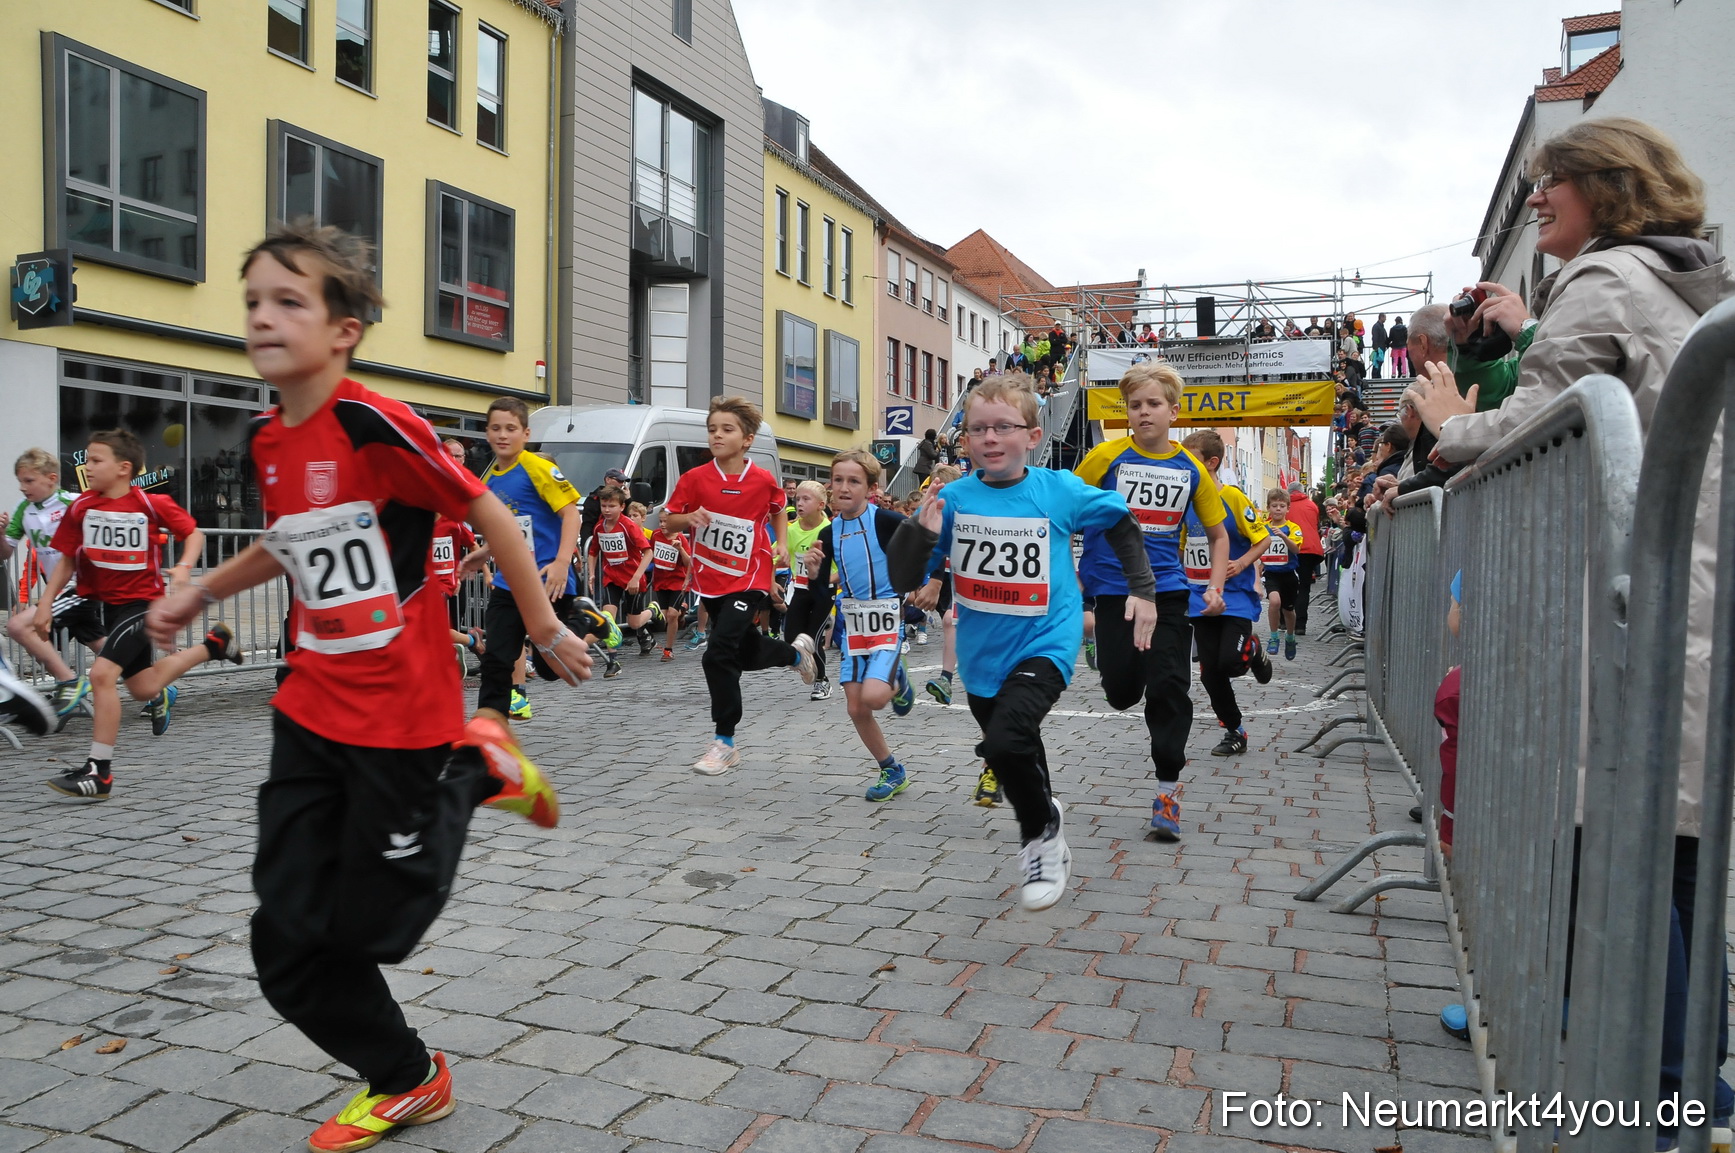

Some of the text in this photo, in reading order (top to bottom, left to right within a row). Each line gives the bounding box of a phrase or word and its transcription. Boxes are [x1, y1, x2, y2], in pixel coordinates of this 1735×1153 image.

[1160, 350, 1284, 362] MW EfficientDynamics
[1179, 391, 1251, 412] TART
[130, 472, 158, 487] WINTER
[1119, 469, 1179, 481] PARTL Neumarkt
[1125, 480, 1184, 508] 7597
[90, 524, 141, 548] 7050
[287, 521, 352, 543] eumarkt
[984, 526, 1034, 537] Neumarkt
[600, 540, 624, 551] 7098
[655, 547, 676, 562] 7069
[957, 537, 1041, 579] 7238
[973, 583, 1020, 604] Philipp
[847, 611, 895, 633] 7106
